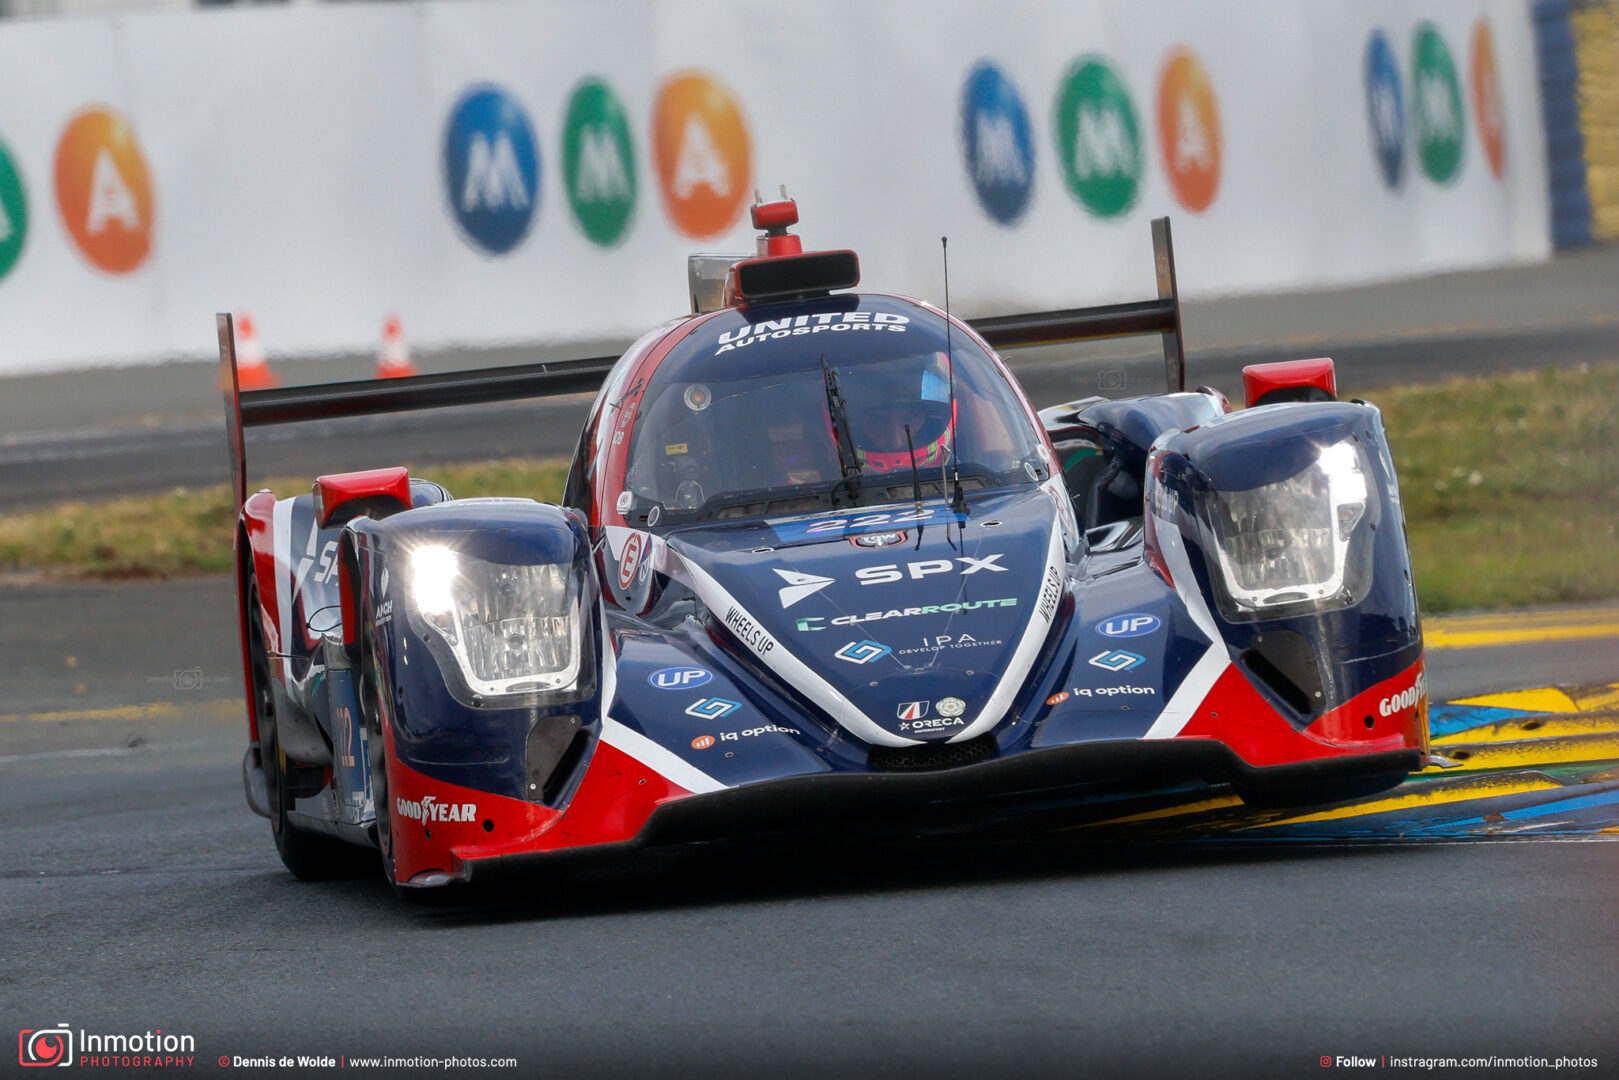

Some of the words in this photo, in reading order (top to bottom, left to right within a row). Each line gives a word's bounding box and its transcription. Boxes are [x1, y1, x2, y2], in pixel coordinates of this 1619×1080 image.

[718, 312, 909, 345] UNITED
[714, 323, 906, 356] AUTOSPORTS
[855, 553, 1009, 586] SPX
[830, 598, 1018, 626] CLEARROUTE
[725, 606, 761, 646] WHEELS
[757, 636, 774, 656] UP
[1106, 616, 1153, 635] UP
[898, 645, 946, 655] DEVELOP
[950, 640, 1002, 649] TOGETHER
[923, 633, 976, 647] IPA
[657, 670, 706, 687] UP
[1073, 687, 1093, 697] iq
[1095, 685, 1156, 697] option
[911, 717, 965, 729] ORECA
[719, 732, 738, 742] iq
[741, 724, 801, 737] option
